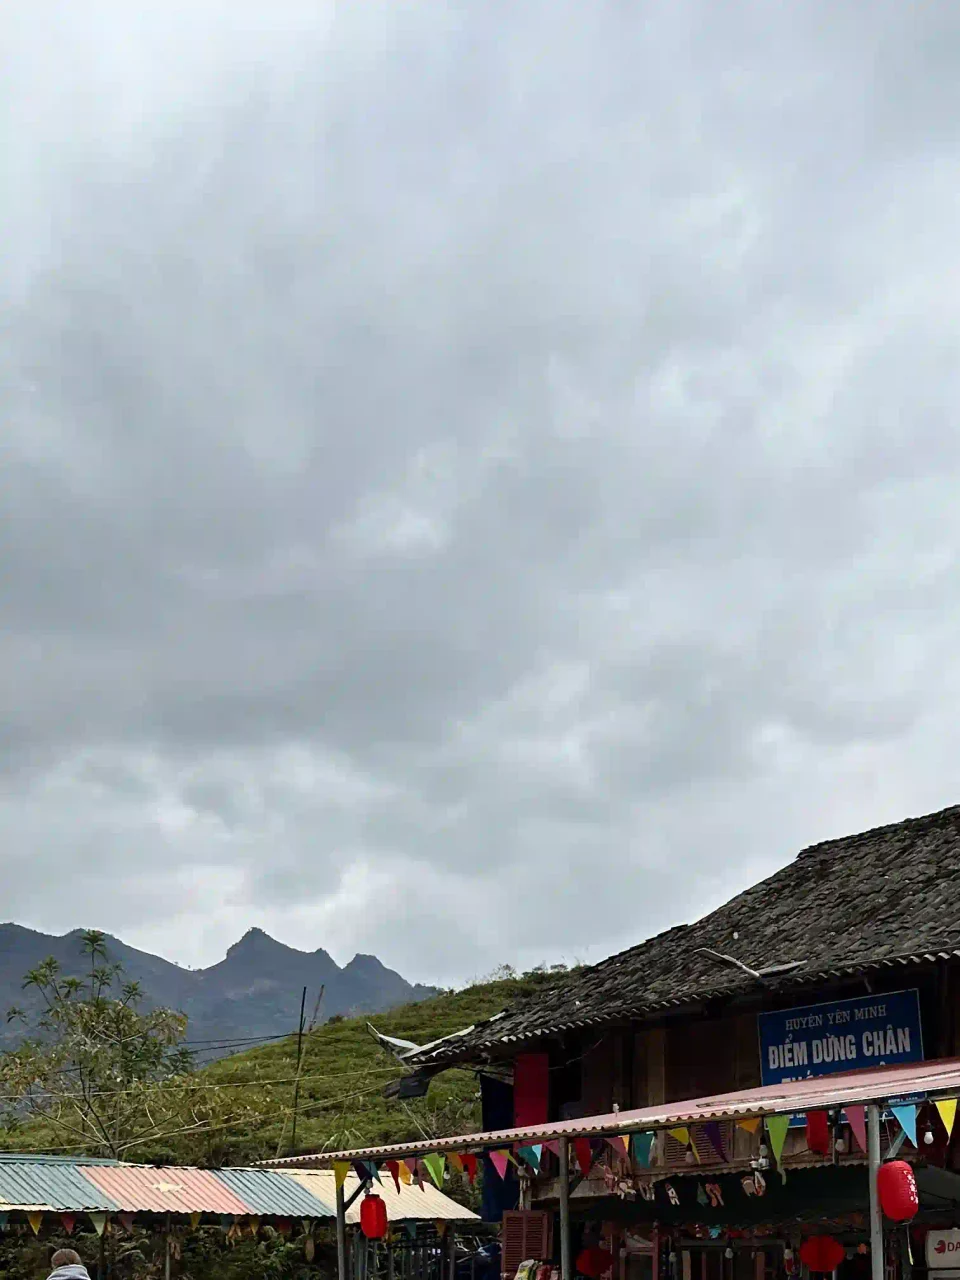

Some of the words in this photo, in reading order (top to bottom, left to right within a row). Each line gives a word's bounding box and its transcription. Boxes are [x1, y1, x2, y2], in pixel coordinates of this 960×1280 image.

[785, 1013, 823, 1031] HUYỆN
[827, 1008, 851, 1025] YÊN
[854, 1004, 887, 1021] MINH
[768, 1033, 809, 1070] ĐIỂM
[812, 1032, 857, 1064] DỪNG
[862, 1024, 911, 1057] CHÂN
